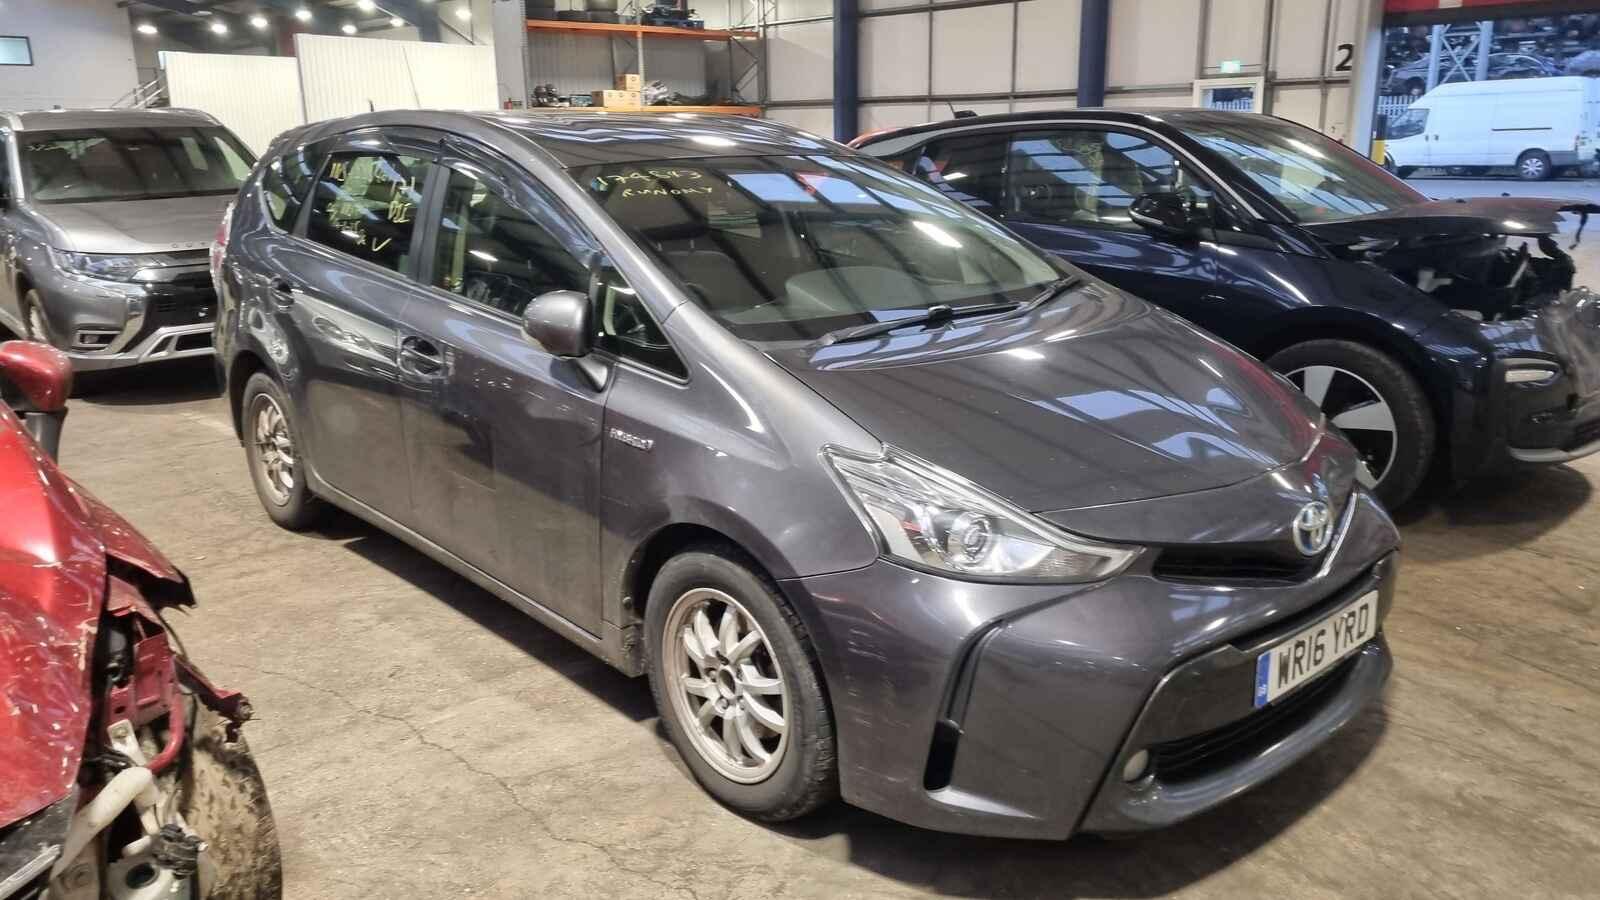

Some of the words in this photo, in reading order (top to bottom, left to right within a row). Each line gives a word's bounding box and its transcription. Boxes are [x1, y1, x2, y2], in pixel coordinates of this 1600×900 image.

[1336, 43, 1353, 72] 2
[1278, 628, 1327, 690] WR16
[1333, 602, 1370, 654] YRD
